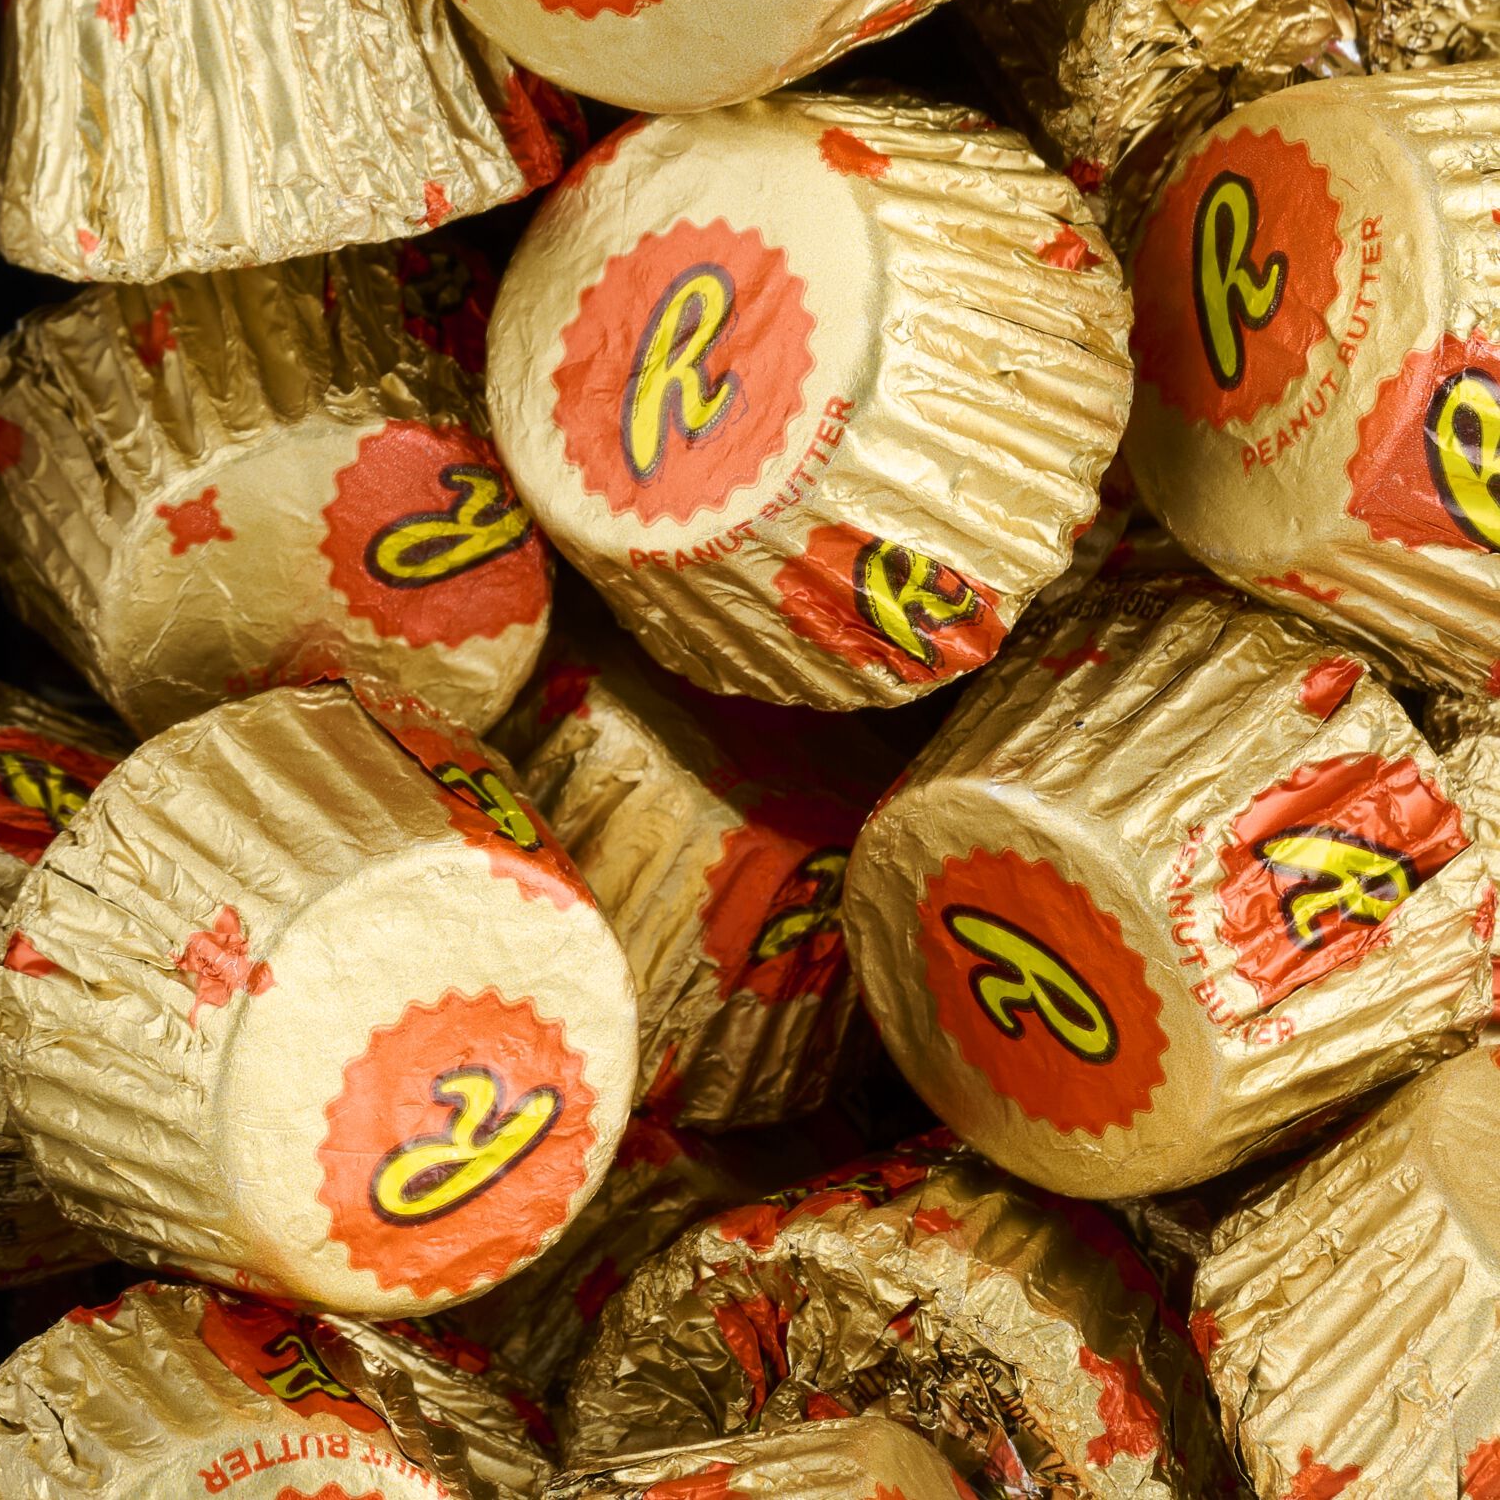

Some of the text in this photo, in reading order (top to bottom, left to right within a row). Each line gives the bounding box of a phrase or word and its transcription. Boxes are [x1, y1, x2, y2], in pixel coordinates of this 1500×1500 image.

[1239, 214, 1384, 479] PEANUT BUTTER
[629, 395, 855, 573] PEANUT BUTTER
[1188, 975, 1297, 1046] BUER
[177, 1432, 352, 1496] BUTTER
